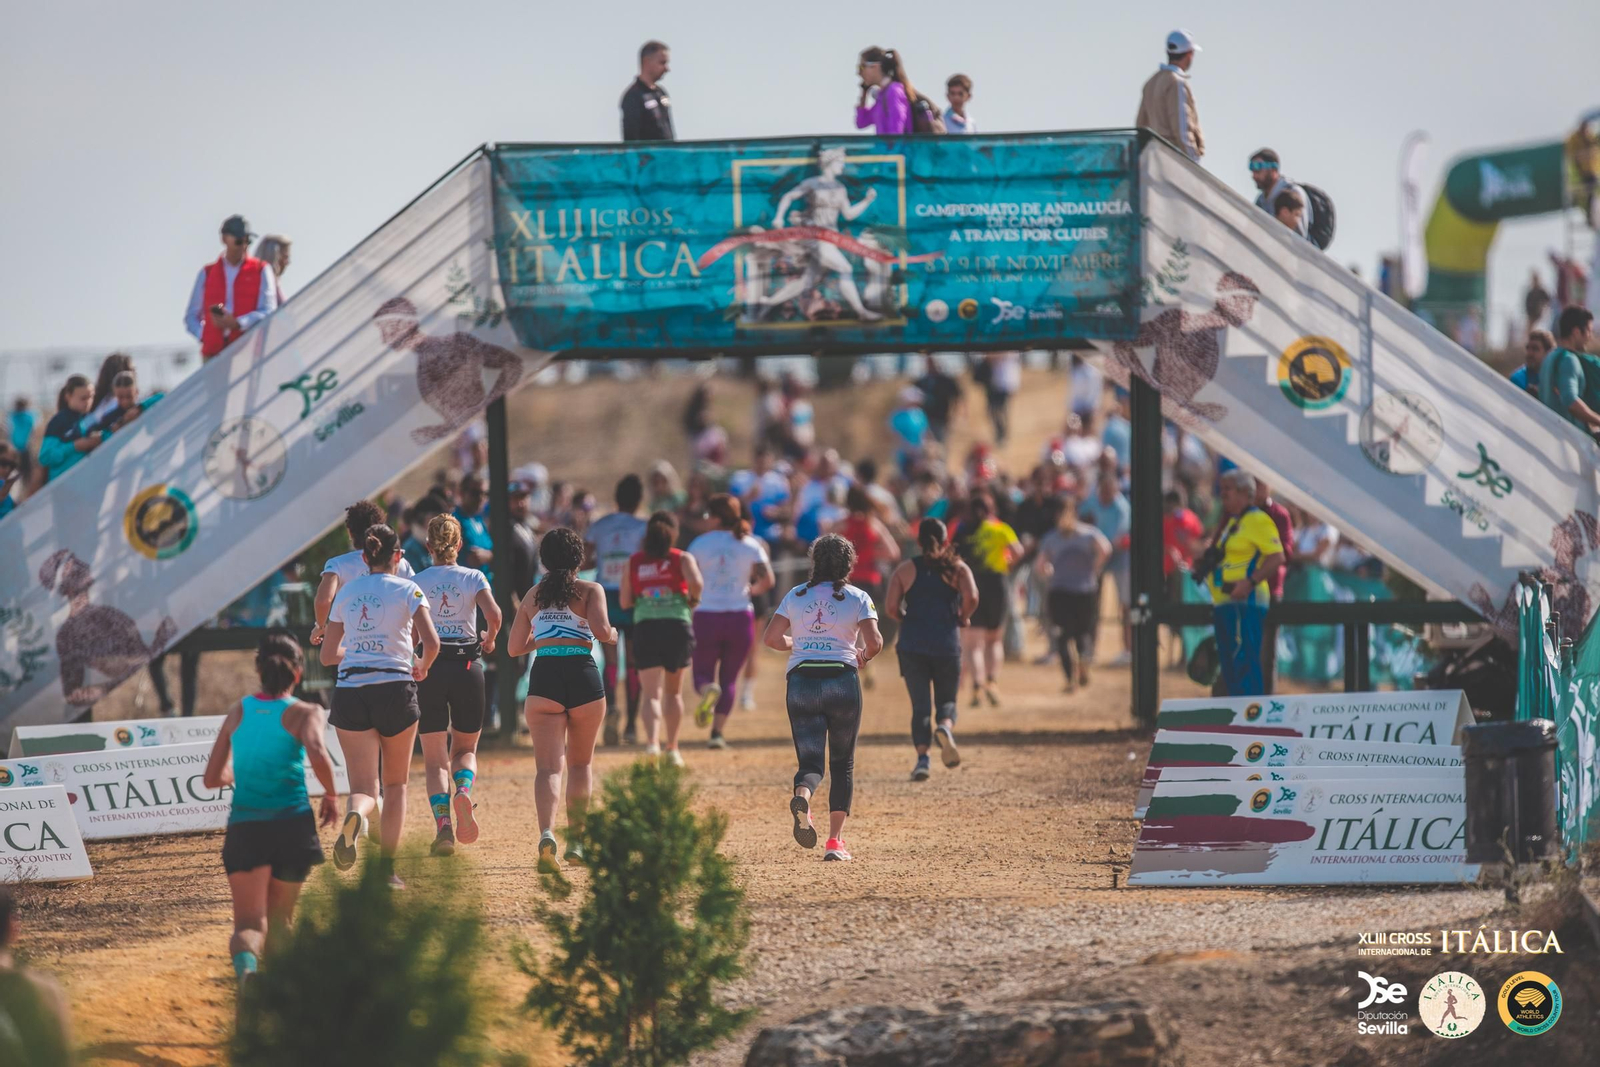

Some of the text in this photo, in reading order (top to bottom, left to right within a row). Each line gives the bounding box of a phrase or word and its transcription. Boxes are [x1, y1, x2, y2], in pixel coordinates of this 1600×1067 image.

[915, 199, 1132, 217] CAMPEONATO DE ANDALUCÍA
[598, 207, 673, 228] CROSS
[1008, 216, 1064, 228] CAMPO
[950, 230, 961, 242] A
[1022, 228, 1052, 241] POR
[1054, 228, 1108, 241] CLUBES
[435, 624, 464, 634] 2025
[354, 640, 384, 654] 2025
[803, 642, 832, 650] 2025
[1313, 702, 1448, 714] CROSS INTERNACIONAL DE
[1318, 751, 1354, 762] CROSS
[1356, 752, 1446, 766] INTERNACIONAL
[73, 762, 112, 774] CROSS
[38, 800, 56, 808] DE
[1330, 794, 1369, 804] CROSS
[89, 810, 168, 823] INTERNATIONAL
[169, 807, 200, 816] CROSS
[1315, 807, 1468, 850] ITÁLICA
[21, 853, 72, 864] COUNTRY
[1310, 856, 1386, 864] INTERNATIONAL
[1390, 855, 1420, 864] CROSS
